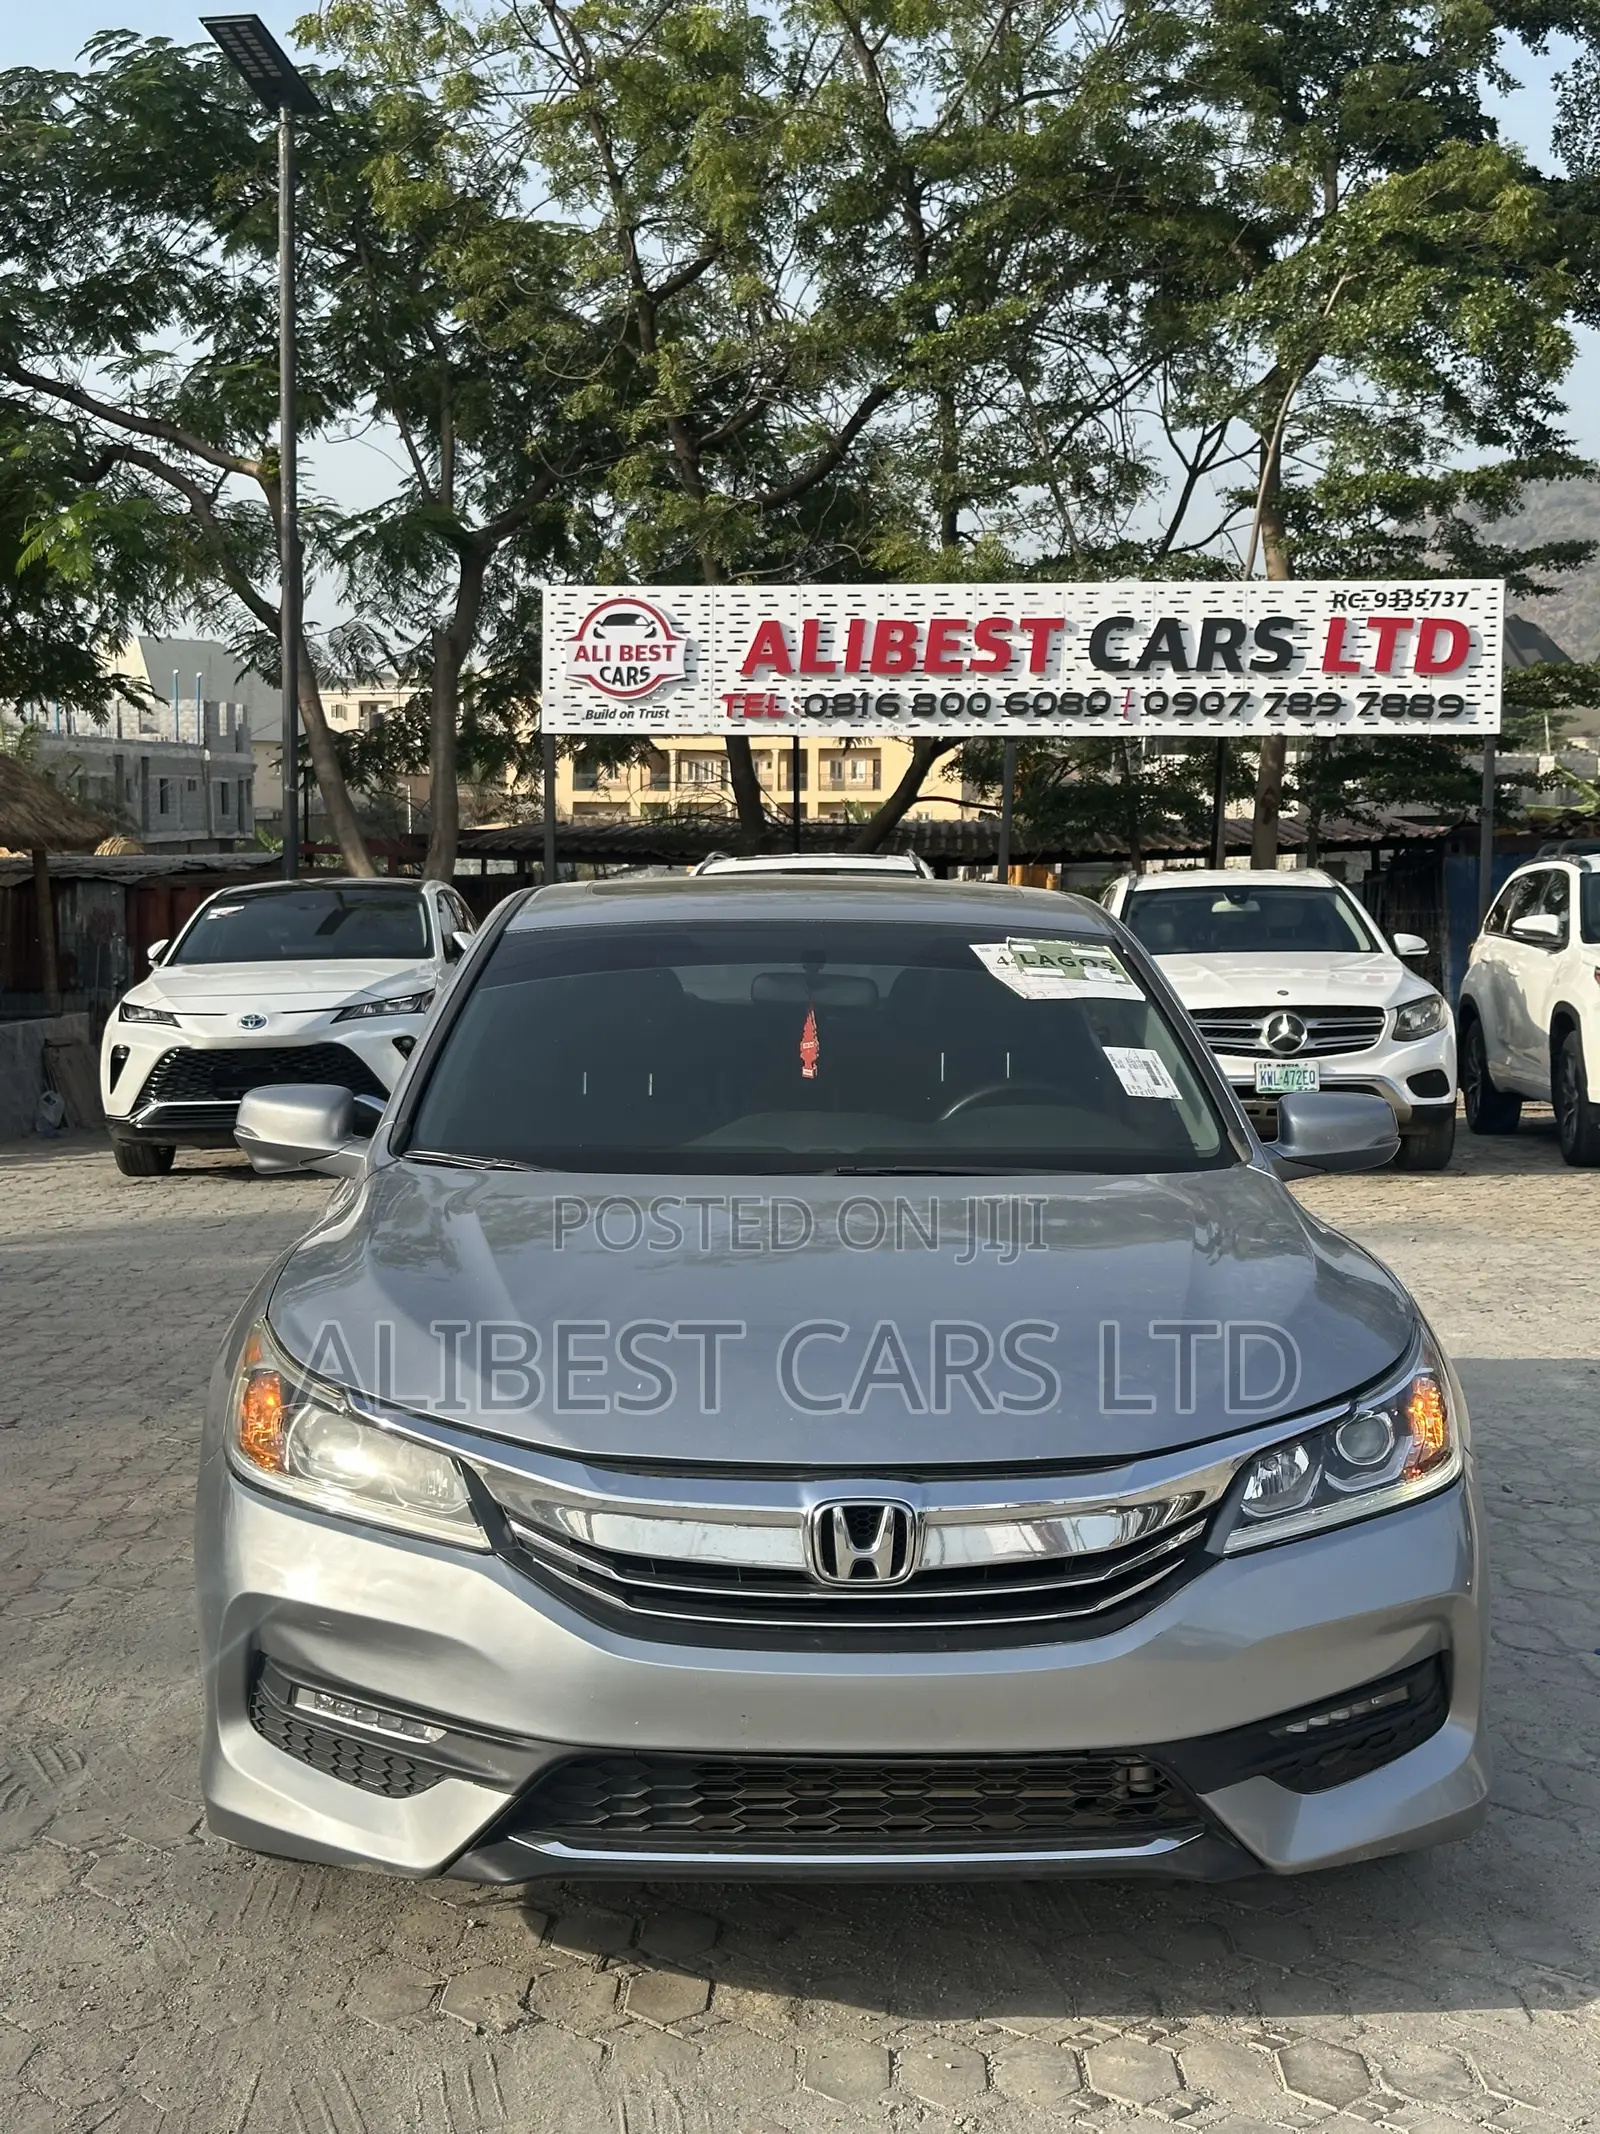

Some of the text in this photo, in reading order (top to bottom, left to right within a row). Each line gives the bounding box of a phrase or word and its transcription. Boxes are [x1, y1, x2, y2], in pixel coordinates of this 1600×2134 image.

[1373, 590, 1469, 609] 9335737
[573, 645, 677, 662] ALI BEST
[740, 616, 1472, 677] ALIBEST CARS LTD
[600, 666, 651, 687] CARS
[585, 708, 671, 720] Build on Trust
[804, 692, 901, 718] 0816
[911, 692, 992, 718] 800
[1005, 690, 1112, 717] 6080
[1144, 690, 1250, 716] 0907
[1263, 691, 1342, 718] 789
[1356, 691, 1465, 719] 7889
[1019, 953, 1117, 972] LAGOS
